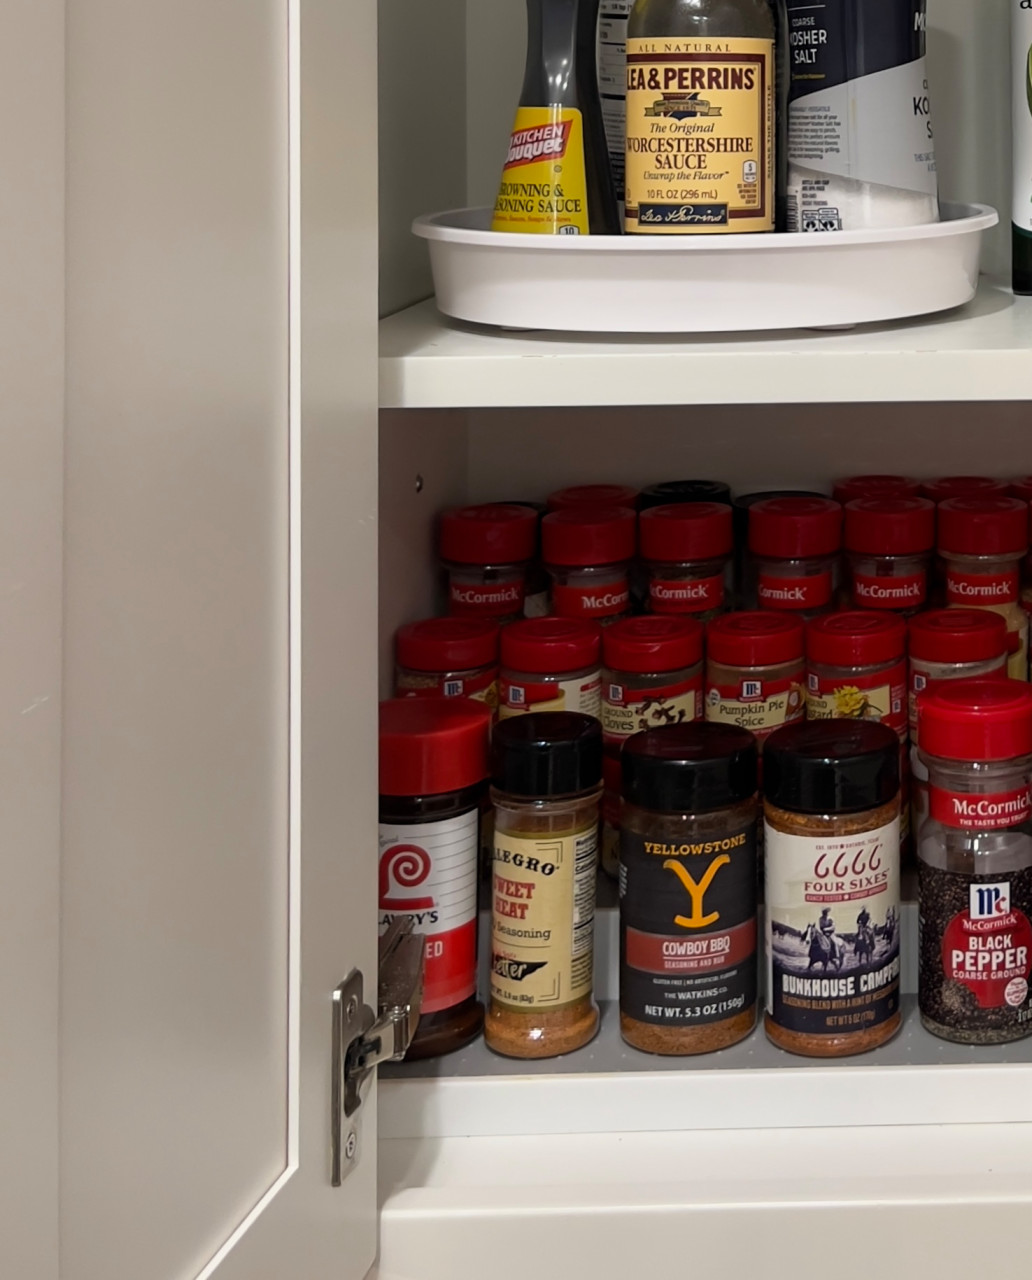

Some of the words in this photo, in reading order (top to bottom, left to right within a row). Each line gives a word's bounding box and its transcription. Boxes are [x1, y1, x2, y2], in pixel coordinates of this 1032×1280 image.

[638, 43, 658, 52] ALL
[664, 43, 731, 52] NATURAL
[794, 48, 817, 64] SALT
[512, 124, 565, 145] KITCHEN
[650, 123, 667, 133] The
[669, 122, 715, 136] Original
[627, 137, 754, 154] WORCESTERSHIRE
[654, 154, 707, 170] SAUCE
[643, 171, 675, 182] Unwrap
[677, 171, 692, 181] the
[554, 184, 564, 197] &
[667, 189, 679, 199] OZ
[538, 198, 582, 213] SAUCE
[452, 586, 520, 604] McCormick
[856, 582, 920, 598] McCormick
[719, 703, 765, 718] Pumpkin
[768, 700, 785, 711] Pie
[735, 716, 765, 728] Spice
[952, 791, 1032, 816] McCormick
[974, 818, 995, 826] TASTE
[996, 816, 1010, 825] YOU
[644, 833, 747, 856] YELLOWSTONE
[804, 881, 845, 892] FOUR
[849, 870, 888, 890] SIXES
[962, 914, 1017, 932] McCormick
[662, 938, 707, 955] COWBOY
[710, 935, 731, 953] BBQ
[968, 934, 1012, 950] BLACK
[664, 959, 699, 968] SEASONING
[951, 946, 1028, 971] PEPPER
[952, 970, 989, 980] COARSE
[990, 966, 1026, 979] GROUND
[782, 973, 855, 997] BUNKHOUSE
[677, 987, 718, 1000] WATKINS
[645, 1004, 663, 1016] NET
[664, 1006, 683, 1018] WT.
[685, 1006, 700, 1017] 5.3
[702, 1003, 717, 1015] OZ
[718, 993, 745, 1013] (150g)
